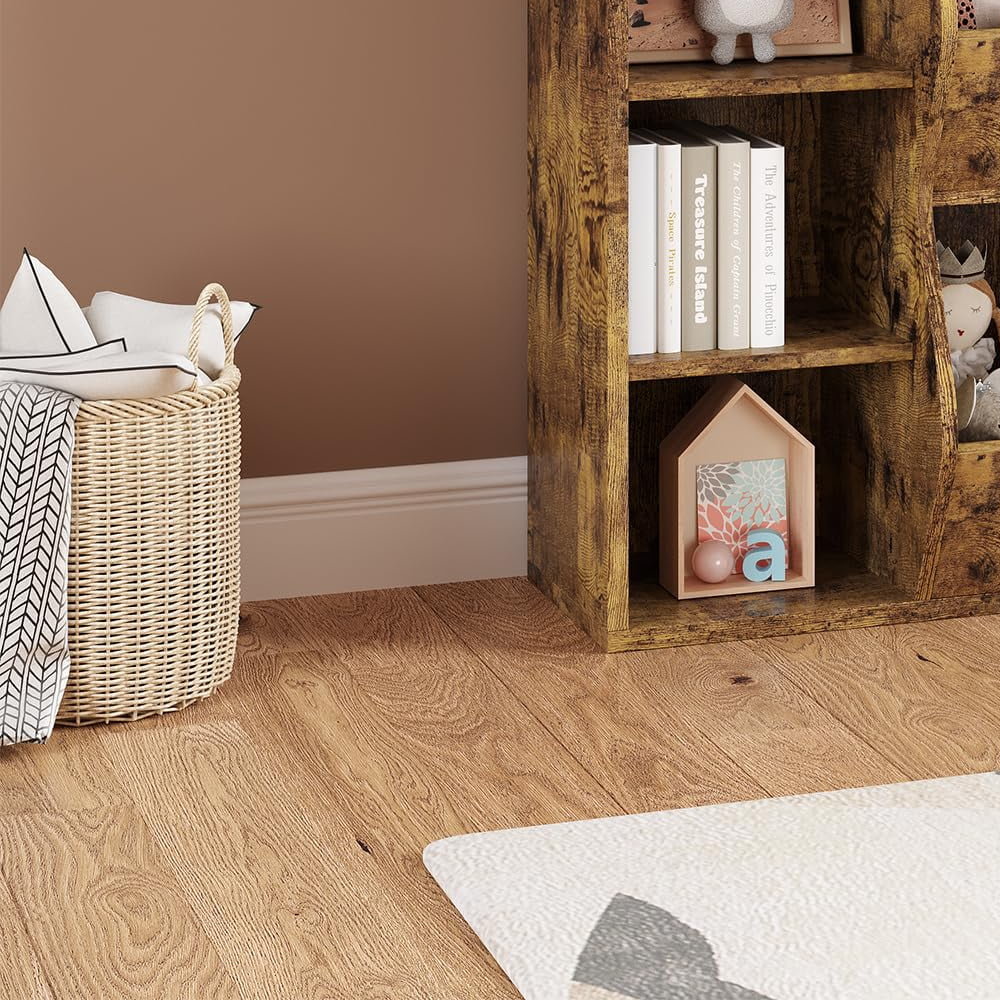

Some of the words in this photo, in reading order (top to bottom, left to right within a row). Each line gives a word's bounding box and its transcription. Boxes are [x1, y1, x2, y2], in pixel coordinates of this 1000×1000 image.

[733, 162, 741, 182] The
[765, 165, 777, 186] The
[667, 212, 676, 242] Space
[694, 174, 708, 261] Treasure
[733, 185, 742, 236] Children
[764, 193, 777, 257] Adventures
[730, 239, 741, 250] of
[668, 249, 676, 287] Pirates
[731, 255, 741, 300] Captain
[764, 265, 776, 276] of
[694, 266, 708, 324] Island
[764, 284, 777, 336] Pinocchio
[742, 528, 786, 583] a
